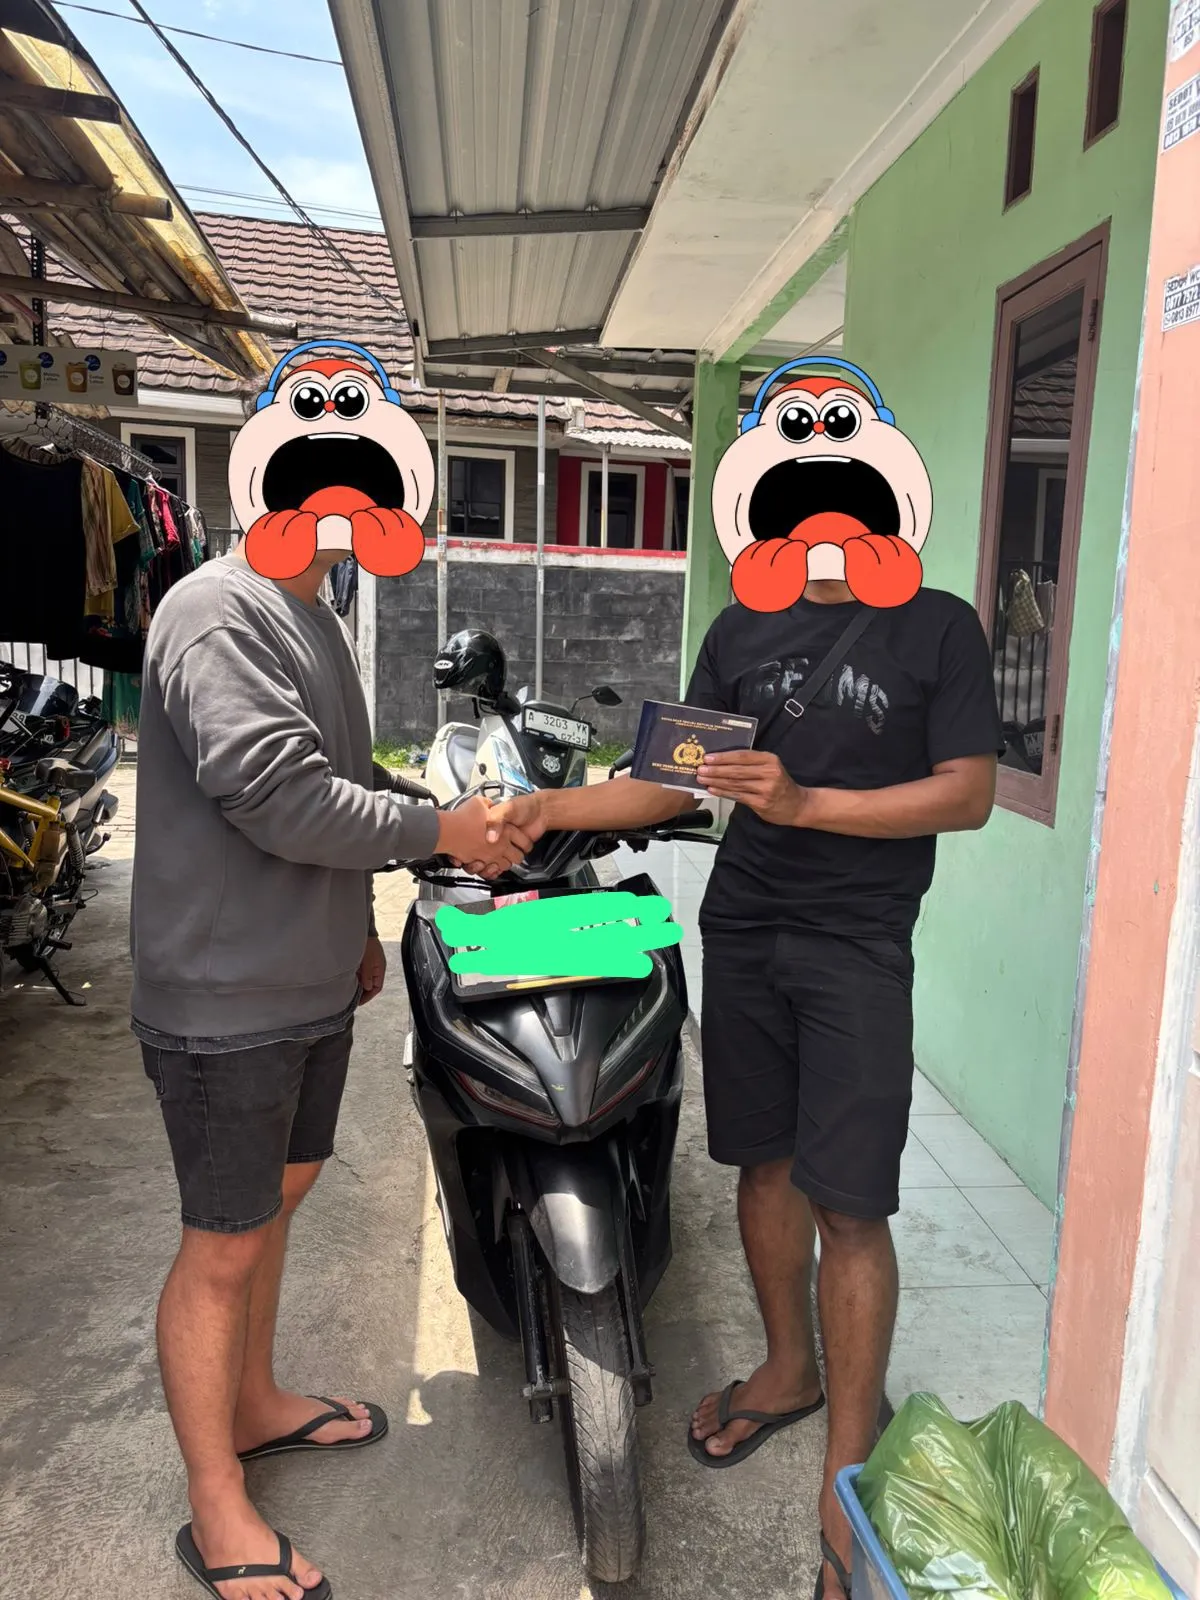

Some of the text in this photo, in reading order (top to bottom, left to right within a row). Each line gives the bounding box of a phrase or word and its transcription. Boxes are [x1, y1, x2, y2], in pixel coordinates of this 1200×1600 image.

[528, 711, 588, 735] A 3203 YK
